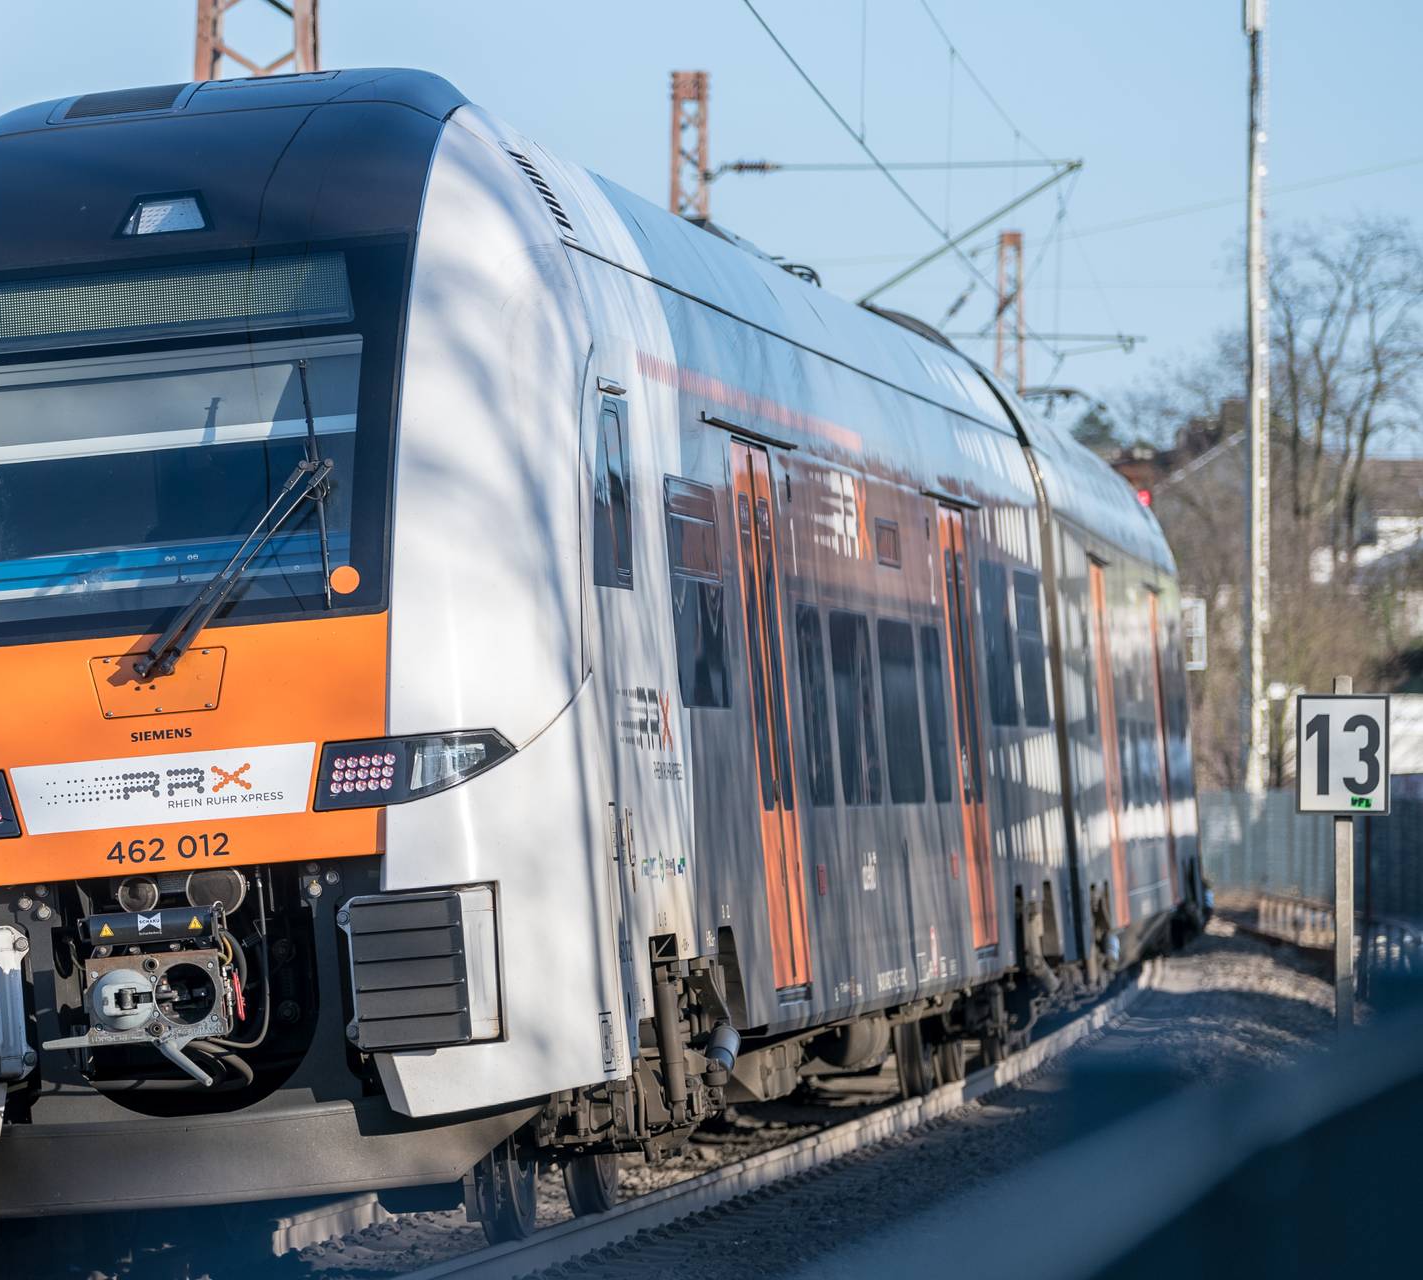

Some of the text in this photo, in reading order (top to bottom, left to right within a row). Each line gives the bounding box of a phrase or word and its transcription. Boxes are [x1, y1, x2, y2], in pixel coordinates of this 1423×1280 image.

[130, 727, 193, 743] SIEMENS
[1305, 713, 1381, 796] 13
[168, 791, 284, 809] RHEIN RUHR XPRESS
[106, 832, 230, 865] 462 012
